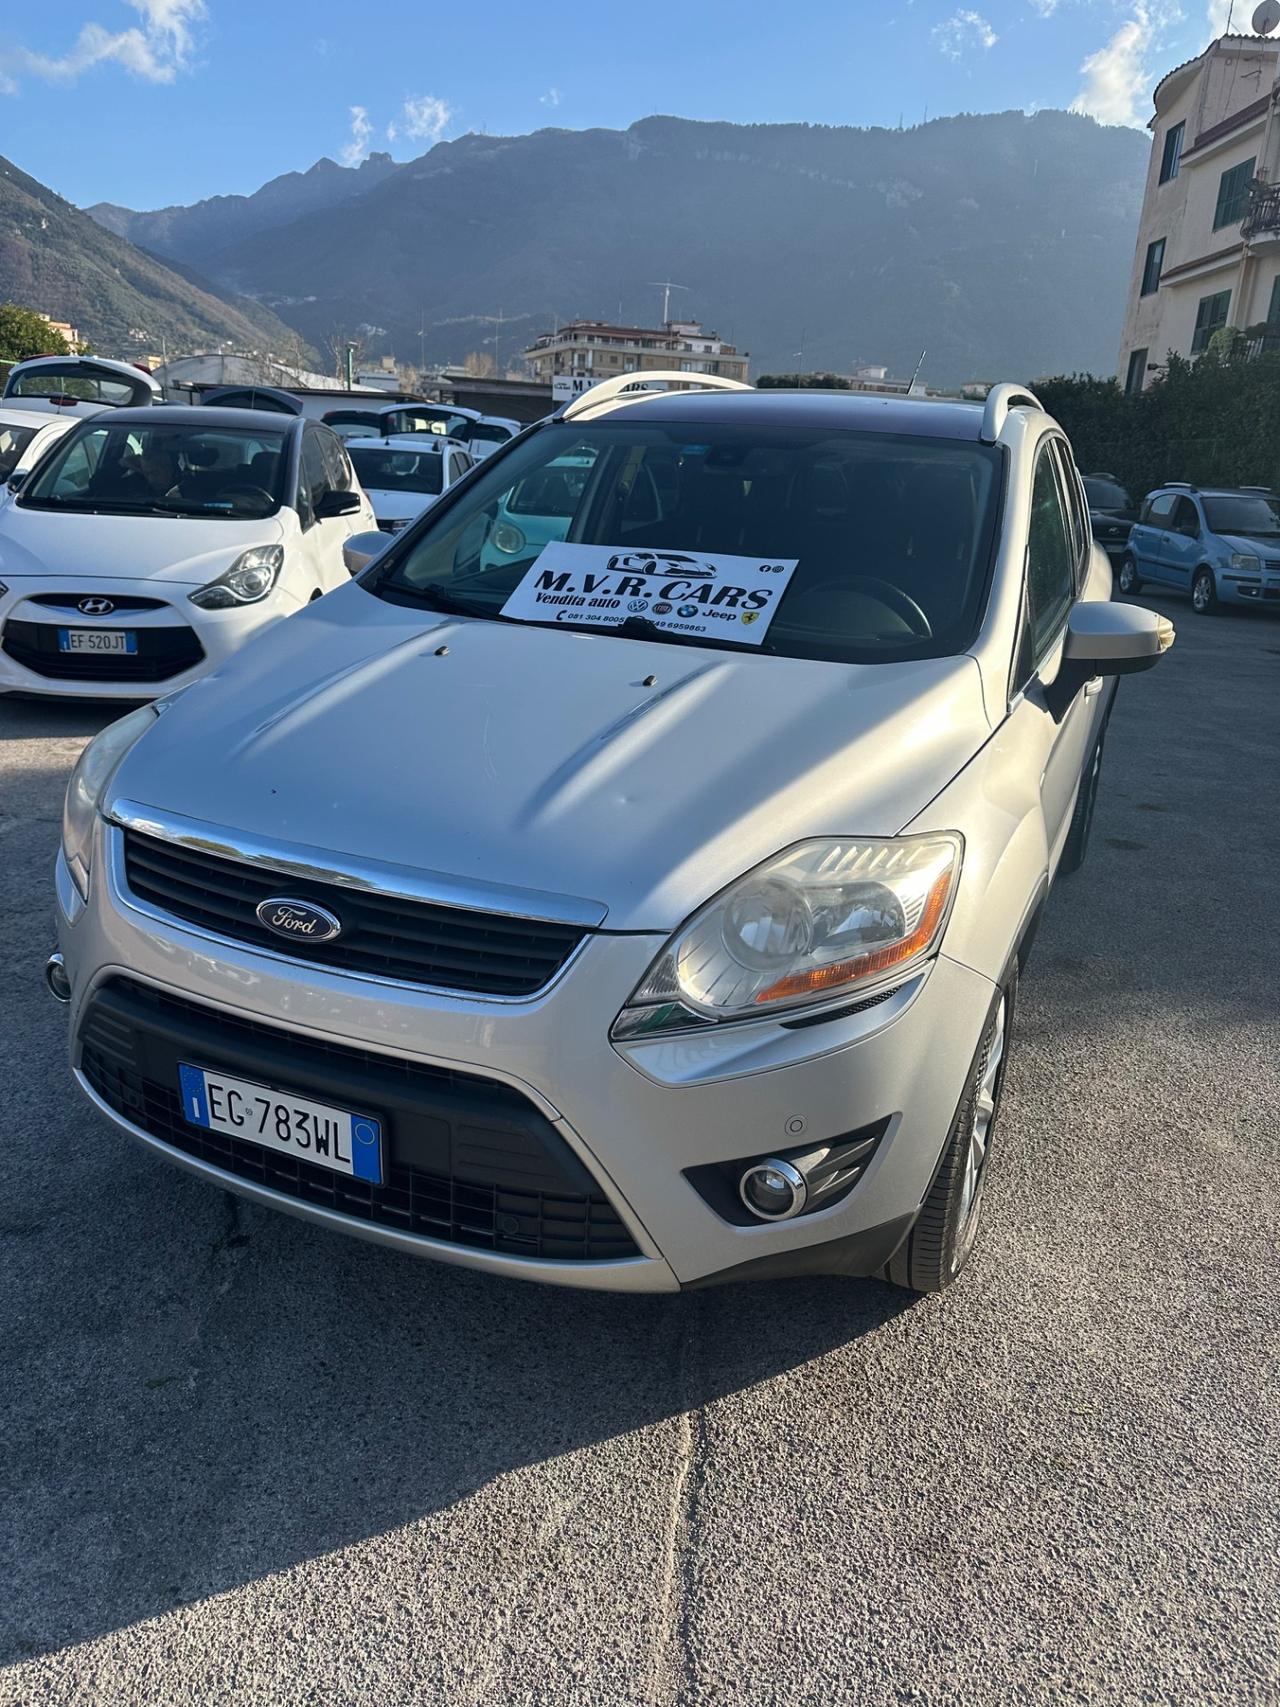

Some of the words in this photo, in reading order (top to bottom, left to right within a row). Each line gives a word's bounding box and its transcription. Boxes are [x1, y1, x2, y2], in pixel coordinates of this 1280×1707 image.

[535, 592, 586, 607] Vendita
[587, 597, 621, 609] auto
[702, 609, 737, 621] Jeep
[70, 634, 85, 649] EF
[88, 634, 125, 650] 520JT
[272, 906, 317, 934] Ford
[207, 1083, 245, 1127] EG
[255, 1097, 351, 1164] 783WL
